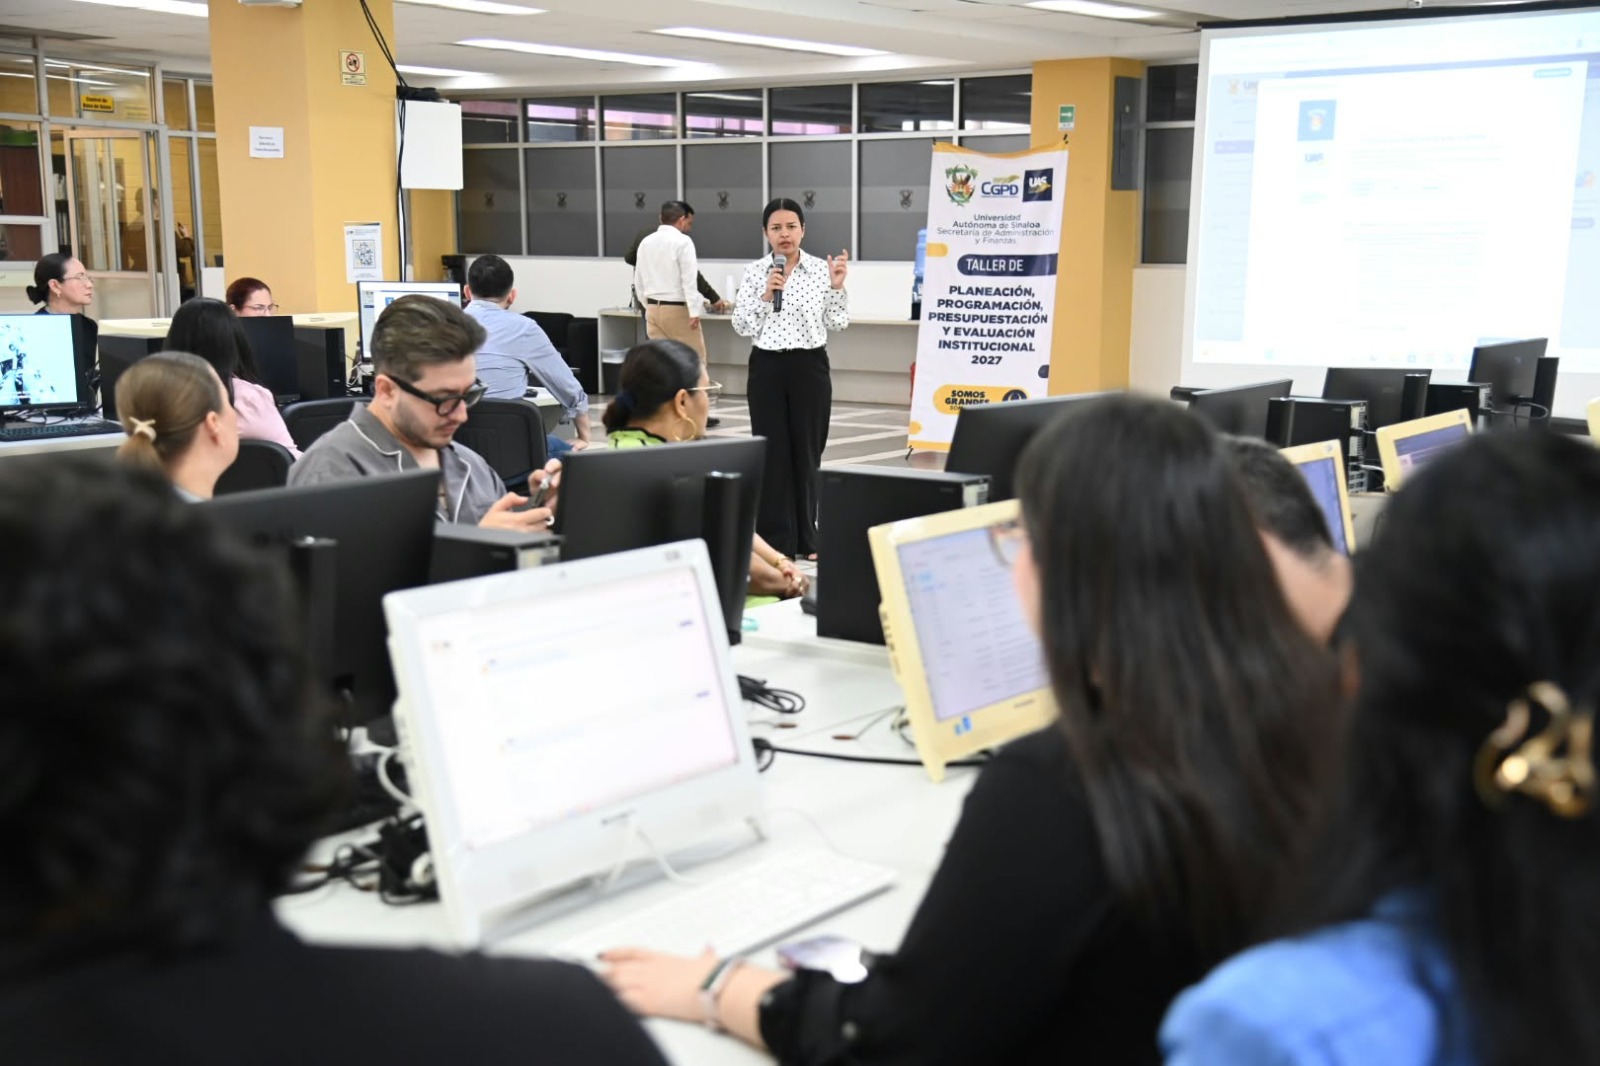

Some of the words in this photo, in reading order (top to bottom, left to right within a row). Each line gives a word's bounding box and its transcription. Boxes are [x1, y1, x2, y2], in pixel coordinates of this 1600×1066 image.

[981, 181, 1018, 196] CGPD
[974, 213, 1021, 221] Universidad
[952, 220, 997, 229] Autónoma
[999, 221, 1009, 229] de
[1011, 221, 1041, 229] Sinaloa
[937, 227, 980, 236] Secretaría
[982, 228, 993, 236] de
[995, 228, 1055, 236] Administración
[975, 237, 980, 245] y
[966, 258, 1006, 272] TALLER
[1008, 258, 1024, 272] DE
[949, 285, 1035, 298] PLANEACIÓN,
[937, 298, 1043, 312] PROGRAMACIÓN,
[928, 312, 1048, 324] PRESUPUESTACIÓN
[942, 326, 951, 336] Y
[953, 326, 1035, 338] EVALUACIÓN
[938, 340, 1035, 352] INSTITUCIONAL
[971, 355, 1002, 365] 2027
[951, 390, 985, 398] SOMOS
